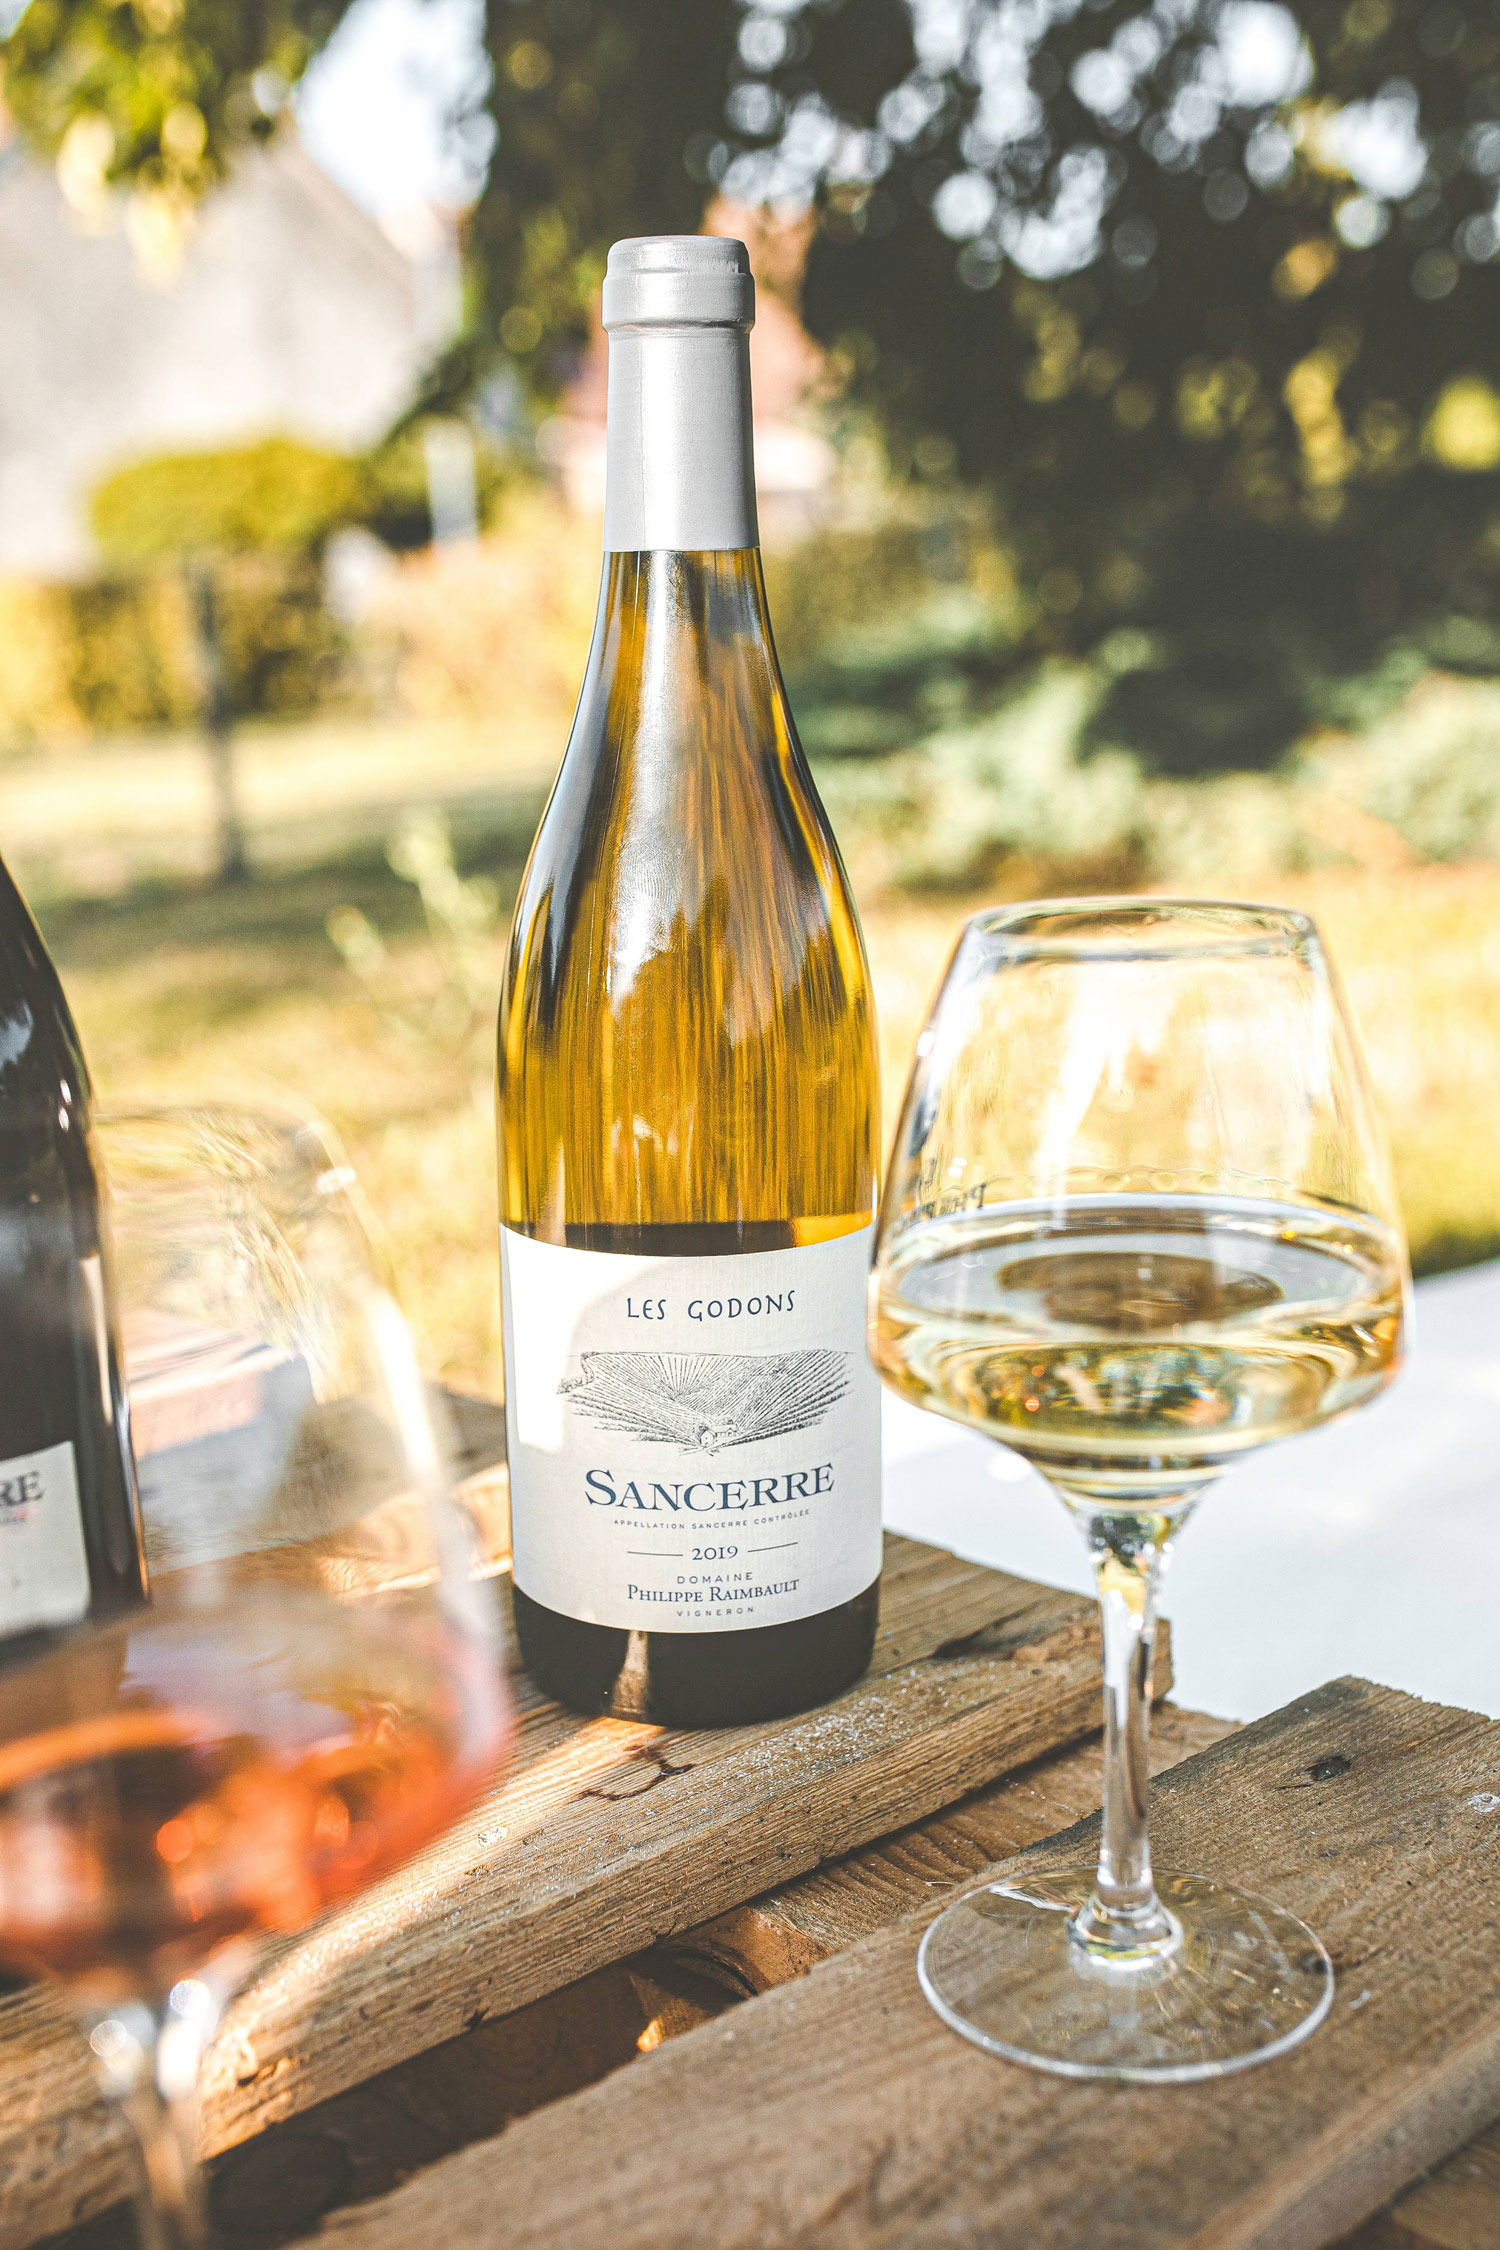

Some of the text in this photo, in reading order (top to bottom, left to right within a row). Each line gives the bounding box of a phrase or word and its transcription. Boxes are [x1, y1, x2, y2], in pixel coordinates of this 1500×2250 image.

[627, 1290, 796, 1321] LES GODONS
[585, 1463, 834, 1511] SANCERRE
[614, 1509, 810, 1529] APPELLATION SANCERRE CONTRÔLÉE
[692, 1546, 738, 1561] 2019
[677, 1572, 753, 1584] DOMAINE
[628, 1579, 800, 1602] PHILIPPE RAIMBAULT
[677, 1606, 754, 1617] VIGNERON
